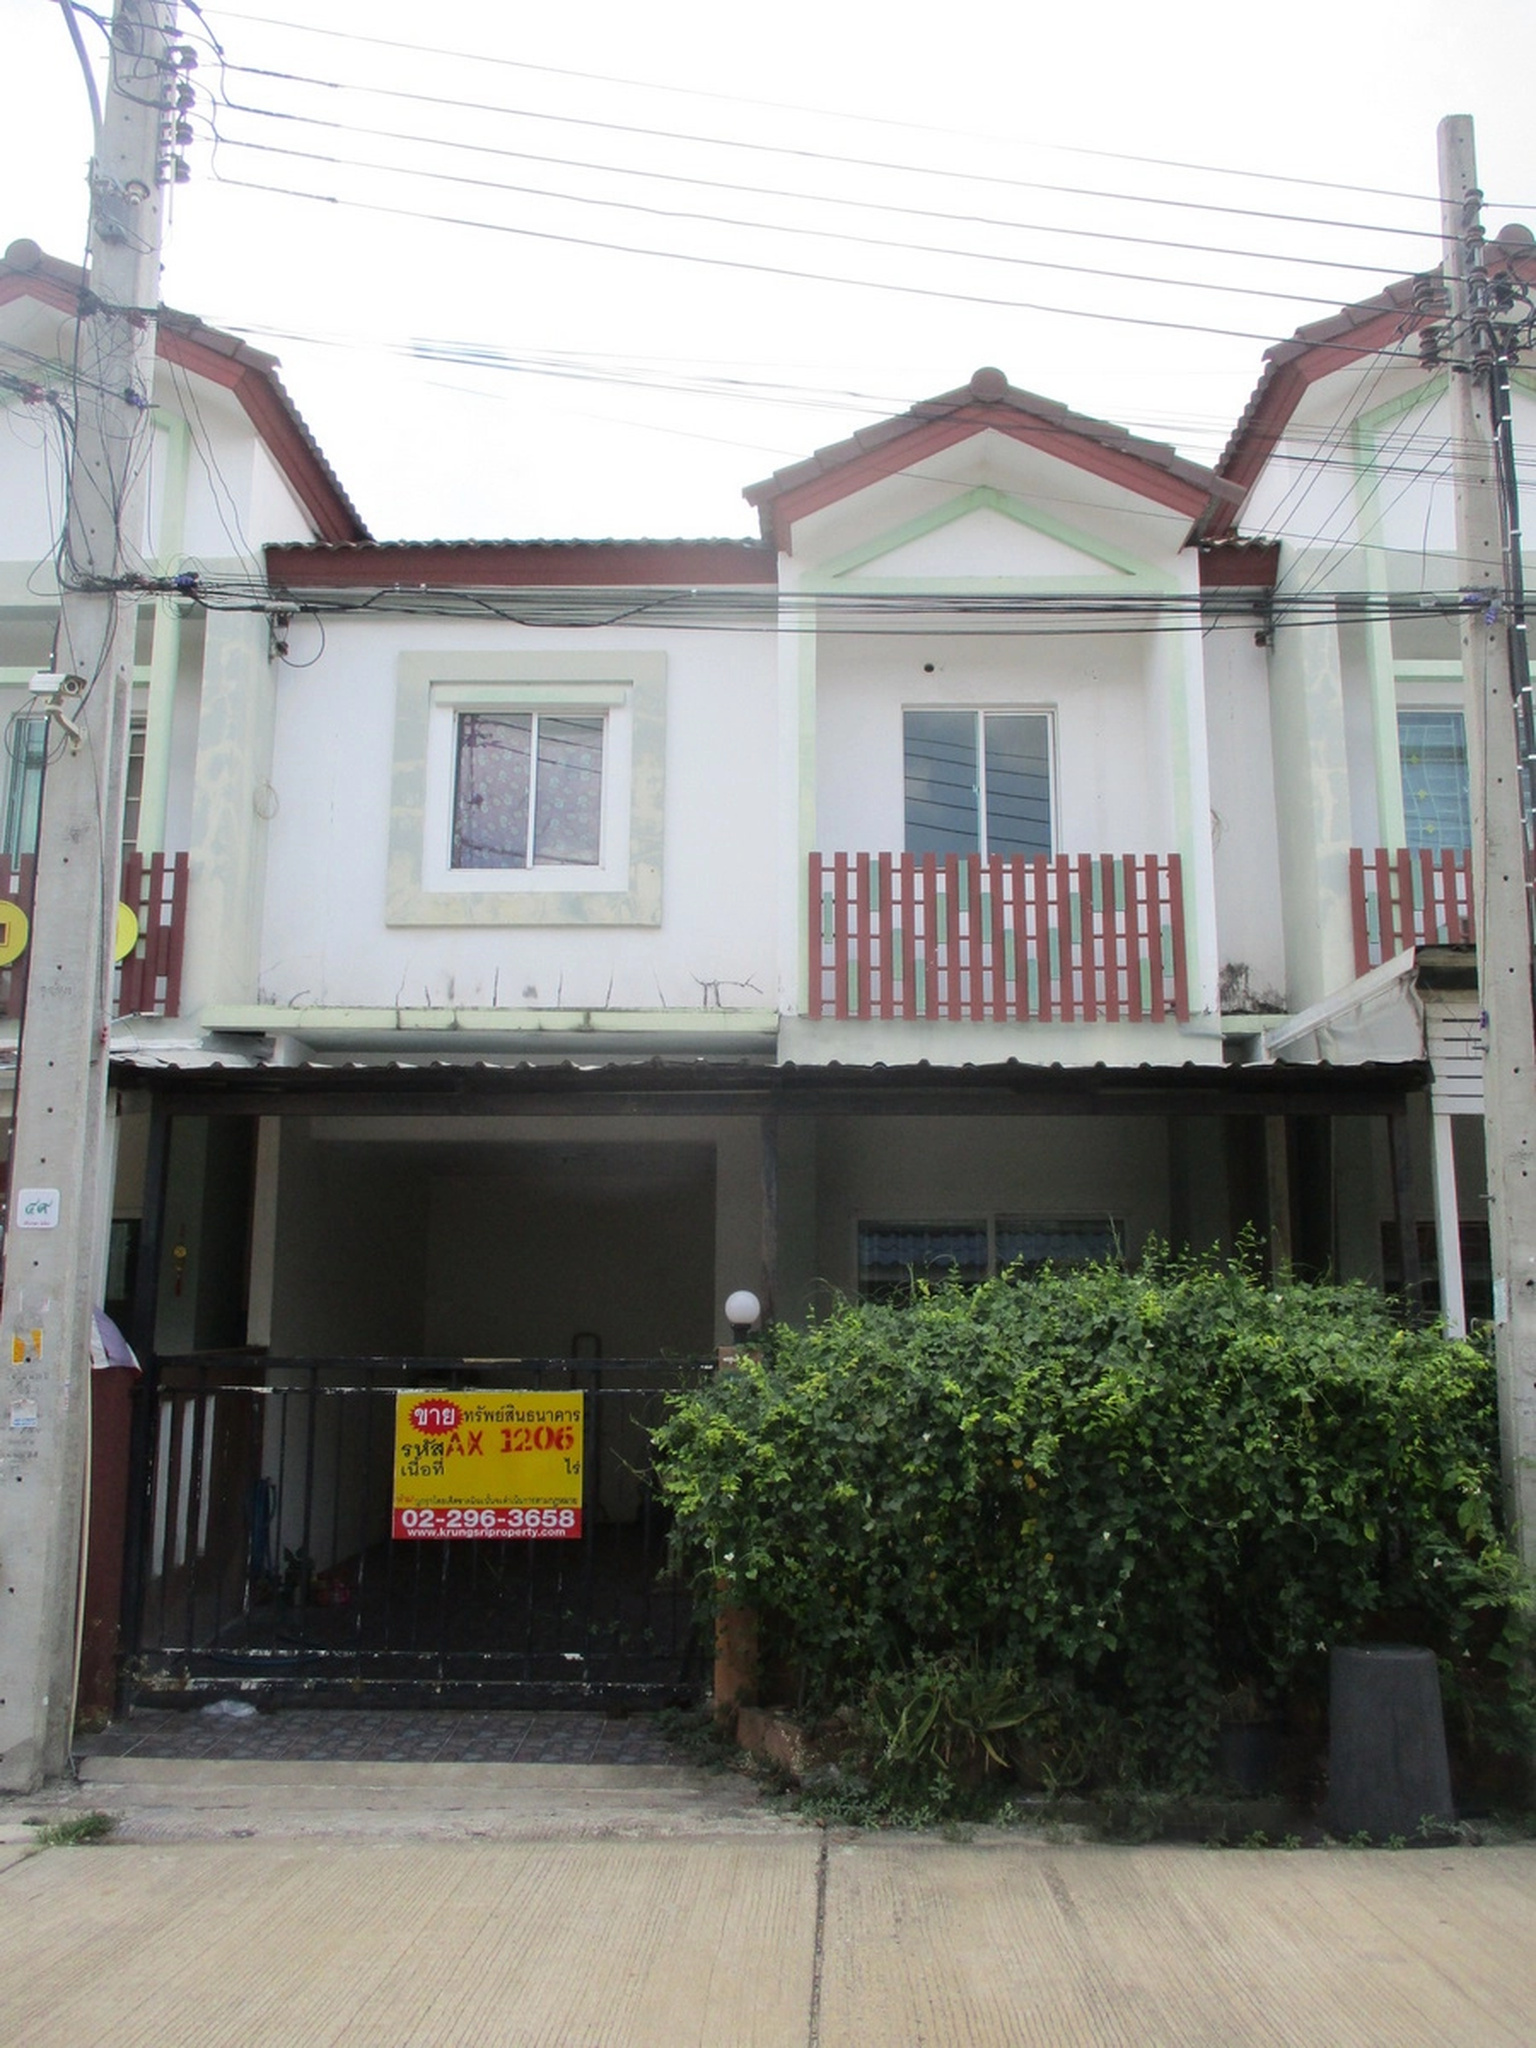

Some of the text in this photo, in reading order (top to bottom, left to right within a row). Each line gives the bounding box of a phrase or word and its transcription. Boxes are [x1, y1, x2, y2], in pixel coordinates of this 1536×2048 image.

[414, 1407, 455, 1426] ขาย
[464, 1404, 581, 1423] ทรัพย์สินธนาคาร
[401, 1426, 575, 1458] รหัส AX 1206
[401, 1456, 581, 1477] เนื้อที่ ไร่
[401, 1508, 575, 1528] 02-296-3658
[407, 1527, 566, 1538] www.krungsriproperty.com
